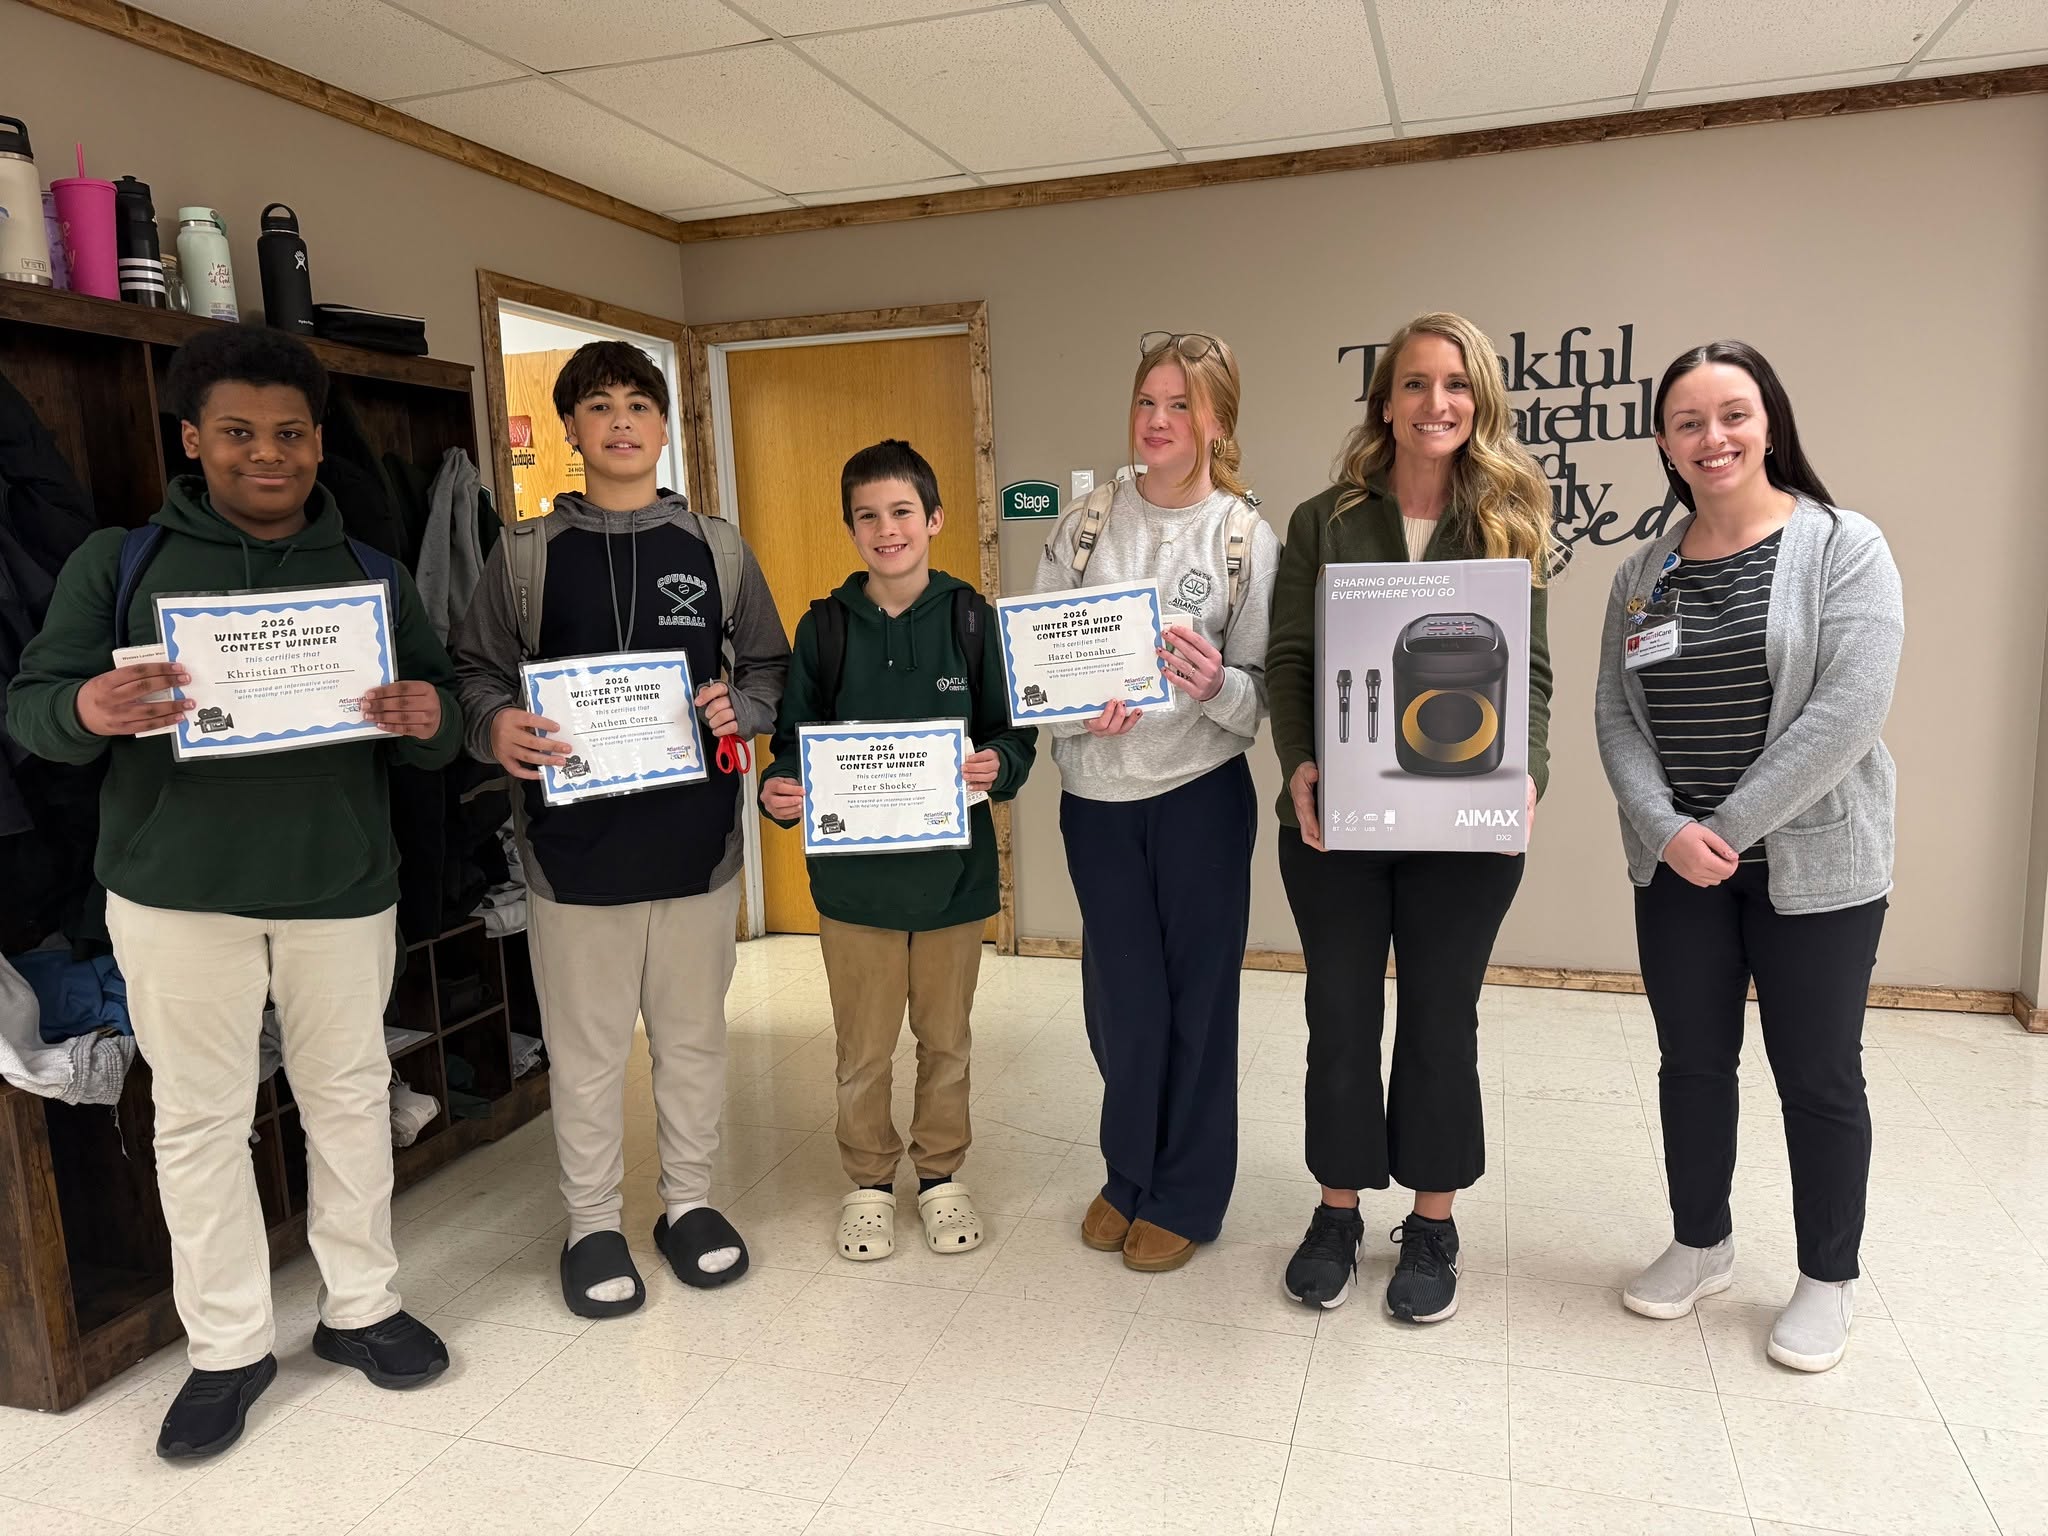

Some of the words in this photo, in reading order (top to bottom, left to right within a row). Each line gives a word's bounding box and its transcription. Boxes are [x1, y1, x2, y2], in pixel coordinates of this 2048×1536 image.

[1338, 324, 1635, 402] Tkful
[1510, 377, 1657, 445] ateful
[1014, 492, 1050, 512] Stage
[656, 573, 708, 592] COUGARS
[1333, 577, 1385, 588] SHARING
[1387, 575, 1450, 586] OPULENCE
[1331, 588, 1409, 600] EVERYWHERE
[1410, 588, 1435, 598] YOU
[1437, 587, 1456, 597] GO
[1172, 598, 1202, 614] ATLANTIC
[1063, 608, 1088, 619] 2026
[261, 616, 294, 628] 2026
[658, 616, 706, 628] BASEBALL
[1032, 621, 1068, 632] WINTER
[1071, 619, 1090, 628] PSA
[1093, 614, 1123, 624] VIDEO
[214, 631, 268, 642] WINTER
[272, 629, 297, 638] PSA
[302, 624, 340, 636] VIDEO
[1036, 630, 1078, 640] CONTEST
[1081, 624, 1121, 635] WINNER
[220, 641, 280, 653] CONTEST
[286, 636, 338, 648] WINNER
[1066, 639, 1093, 648] certifies
[265, 653, 300, 662] certifies
[303, 650, 320, 658] that
[1048, 651, 1073, 662] Hazel
[1076, 648, 1116, 659] Donahue
[227, 666, 286, 680] Khristian
[291, 662, 340, 673] Thorton
[605, 676, 629, 686] 2026
[570, 688, 611, 699] WINTER
[614, 685, 632, 694] PSA
[634, 683, 661, 692] VIDEO
[339, 696, 366, 704] Atlanti
[576, 696, 622, 708] CONTEST
[624, 692, 660, 702] WINNER
[595, 708, 609, 716] This
[610, 706, 636, 714] certifies
[590, 718, 628, 729] Anthem
[630, 716, 658, 724] Correa
[870, 744, 894, 752] 2026
[836, 754, 874, 762] WINTER
[898, 752, 928, 760] VIDEO
[840, 762, 884, 770] CONTEST
[886, 760, 925, 768] WINNER
[852, 784, 877, 792] Peter
[880, 782, 917, 790] Shockey
[1454, 809, 1520, 826] AIMAX
